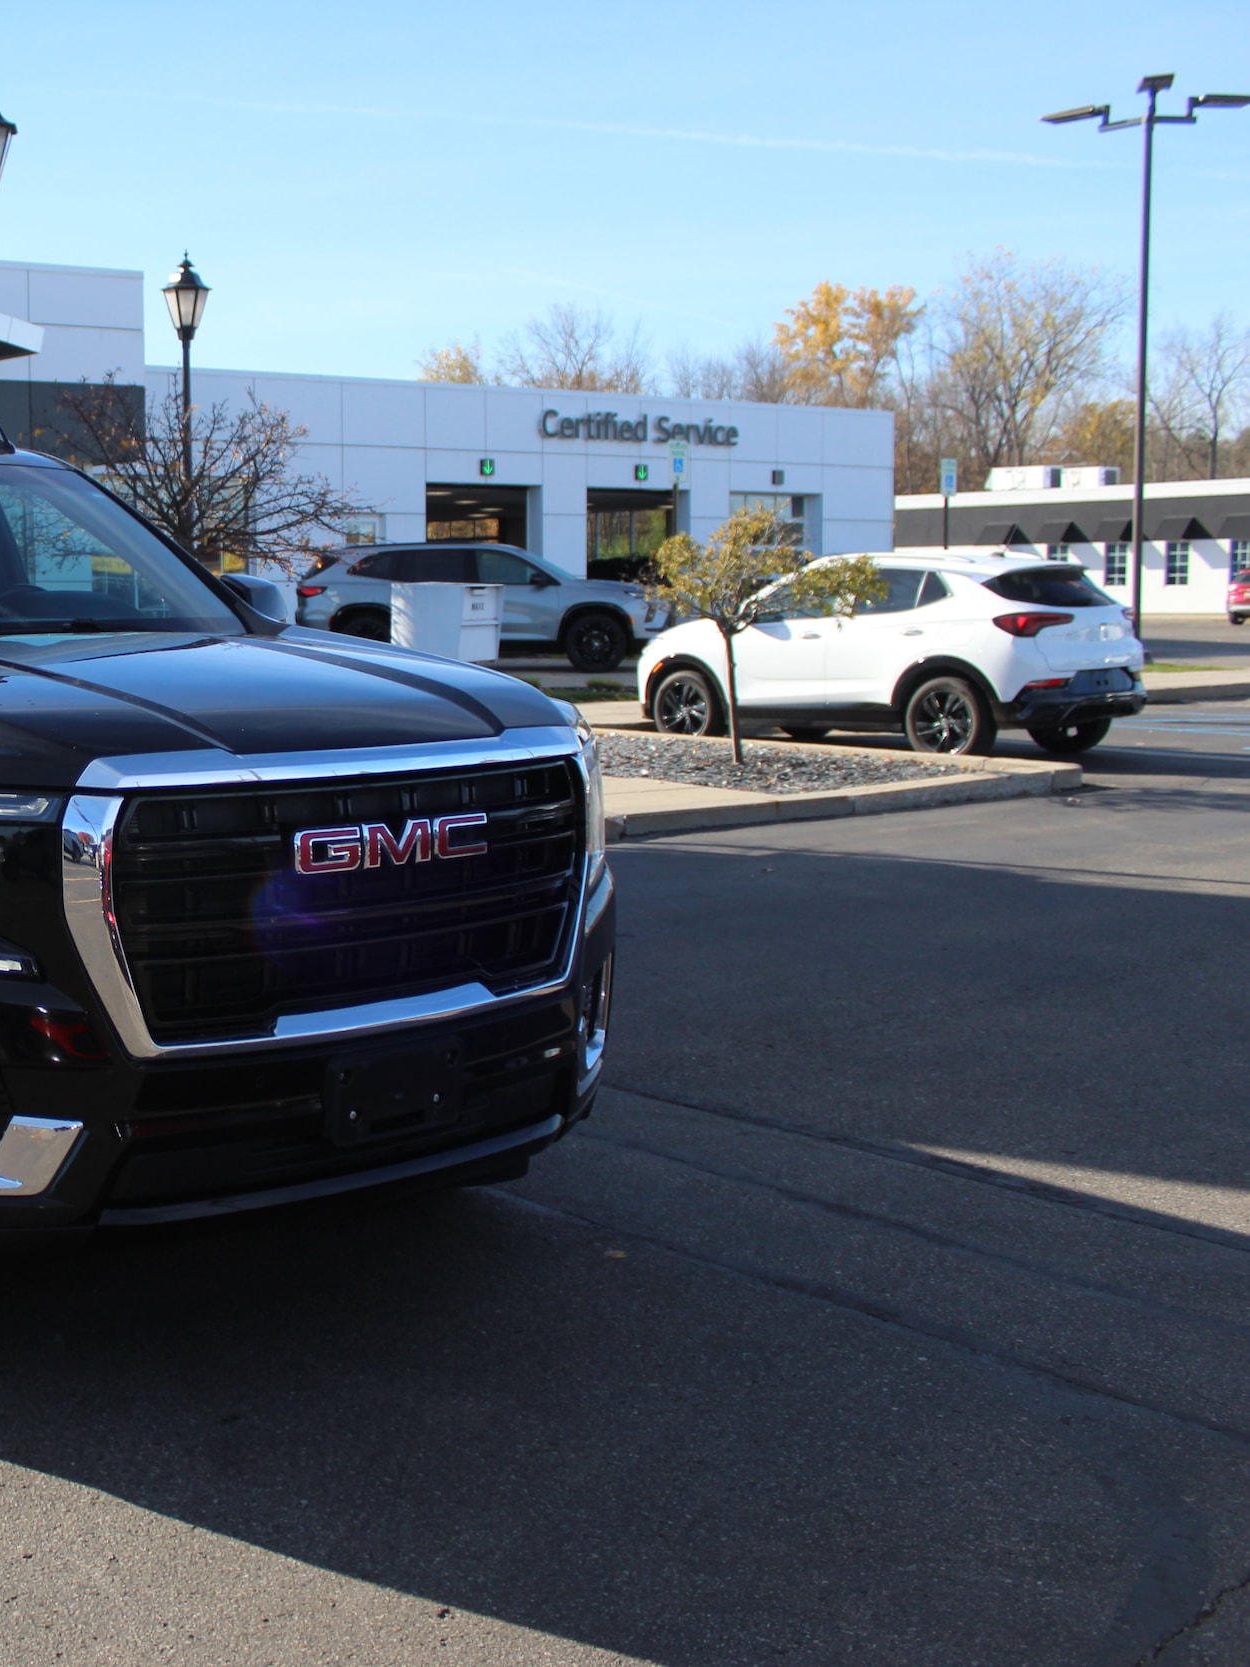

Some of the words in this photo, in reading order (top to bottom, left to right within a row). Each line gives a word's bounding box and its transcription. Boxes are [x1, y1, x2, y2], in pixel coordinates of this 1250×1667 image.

[540, 409, 648, 442] Certified
[653, 415, 739, 446] Service
[294, 813, 488, 875] GMC
